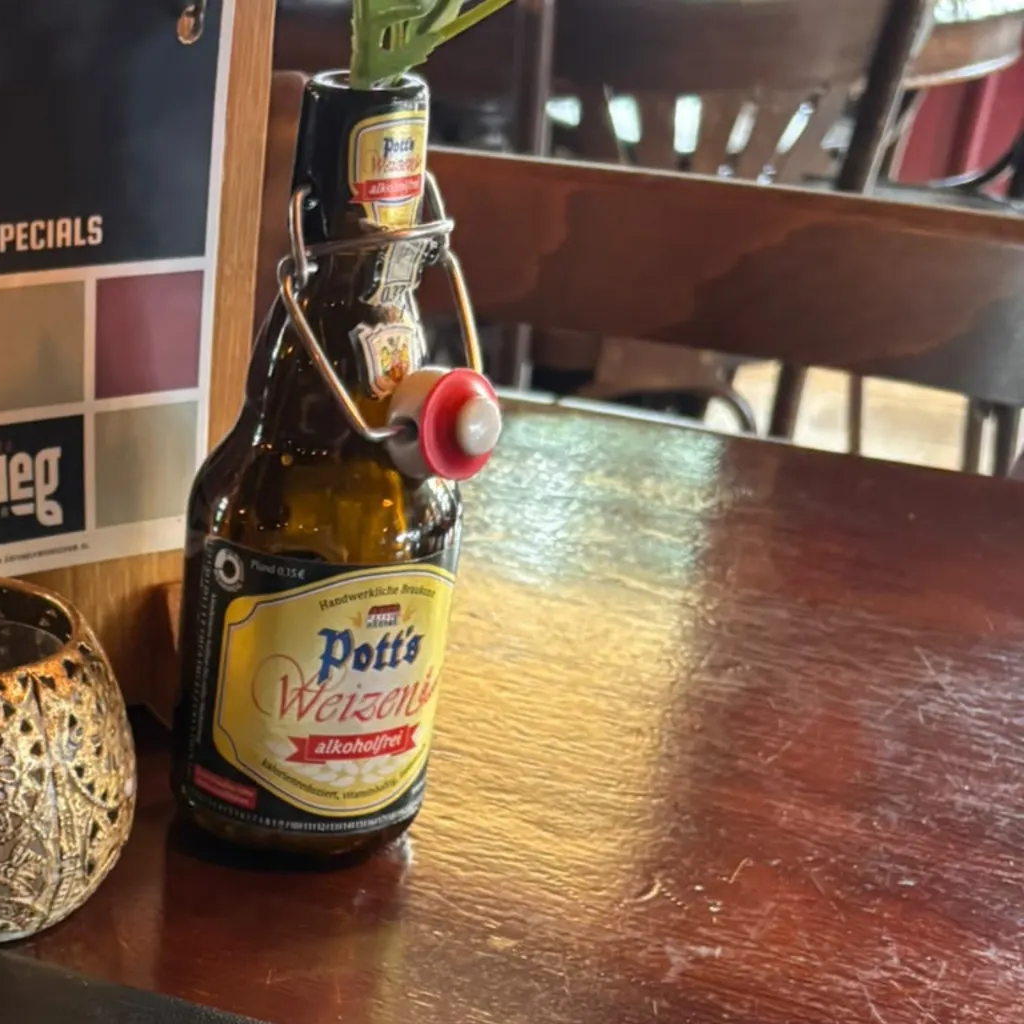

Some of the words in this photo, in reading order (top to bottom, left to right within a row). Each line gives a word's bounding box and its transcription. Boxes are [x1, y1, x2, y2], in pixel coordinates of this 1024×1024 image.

[318, 585, 399, 612] Handwerkliche
[317, 625, 426, 685] Pott's
[314, 729, 403, 755] alkoholfrei
